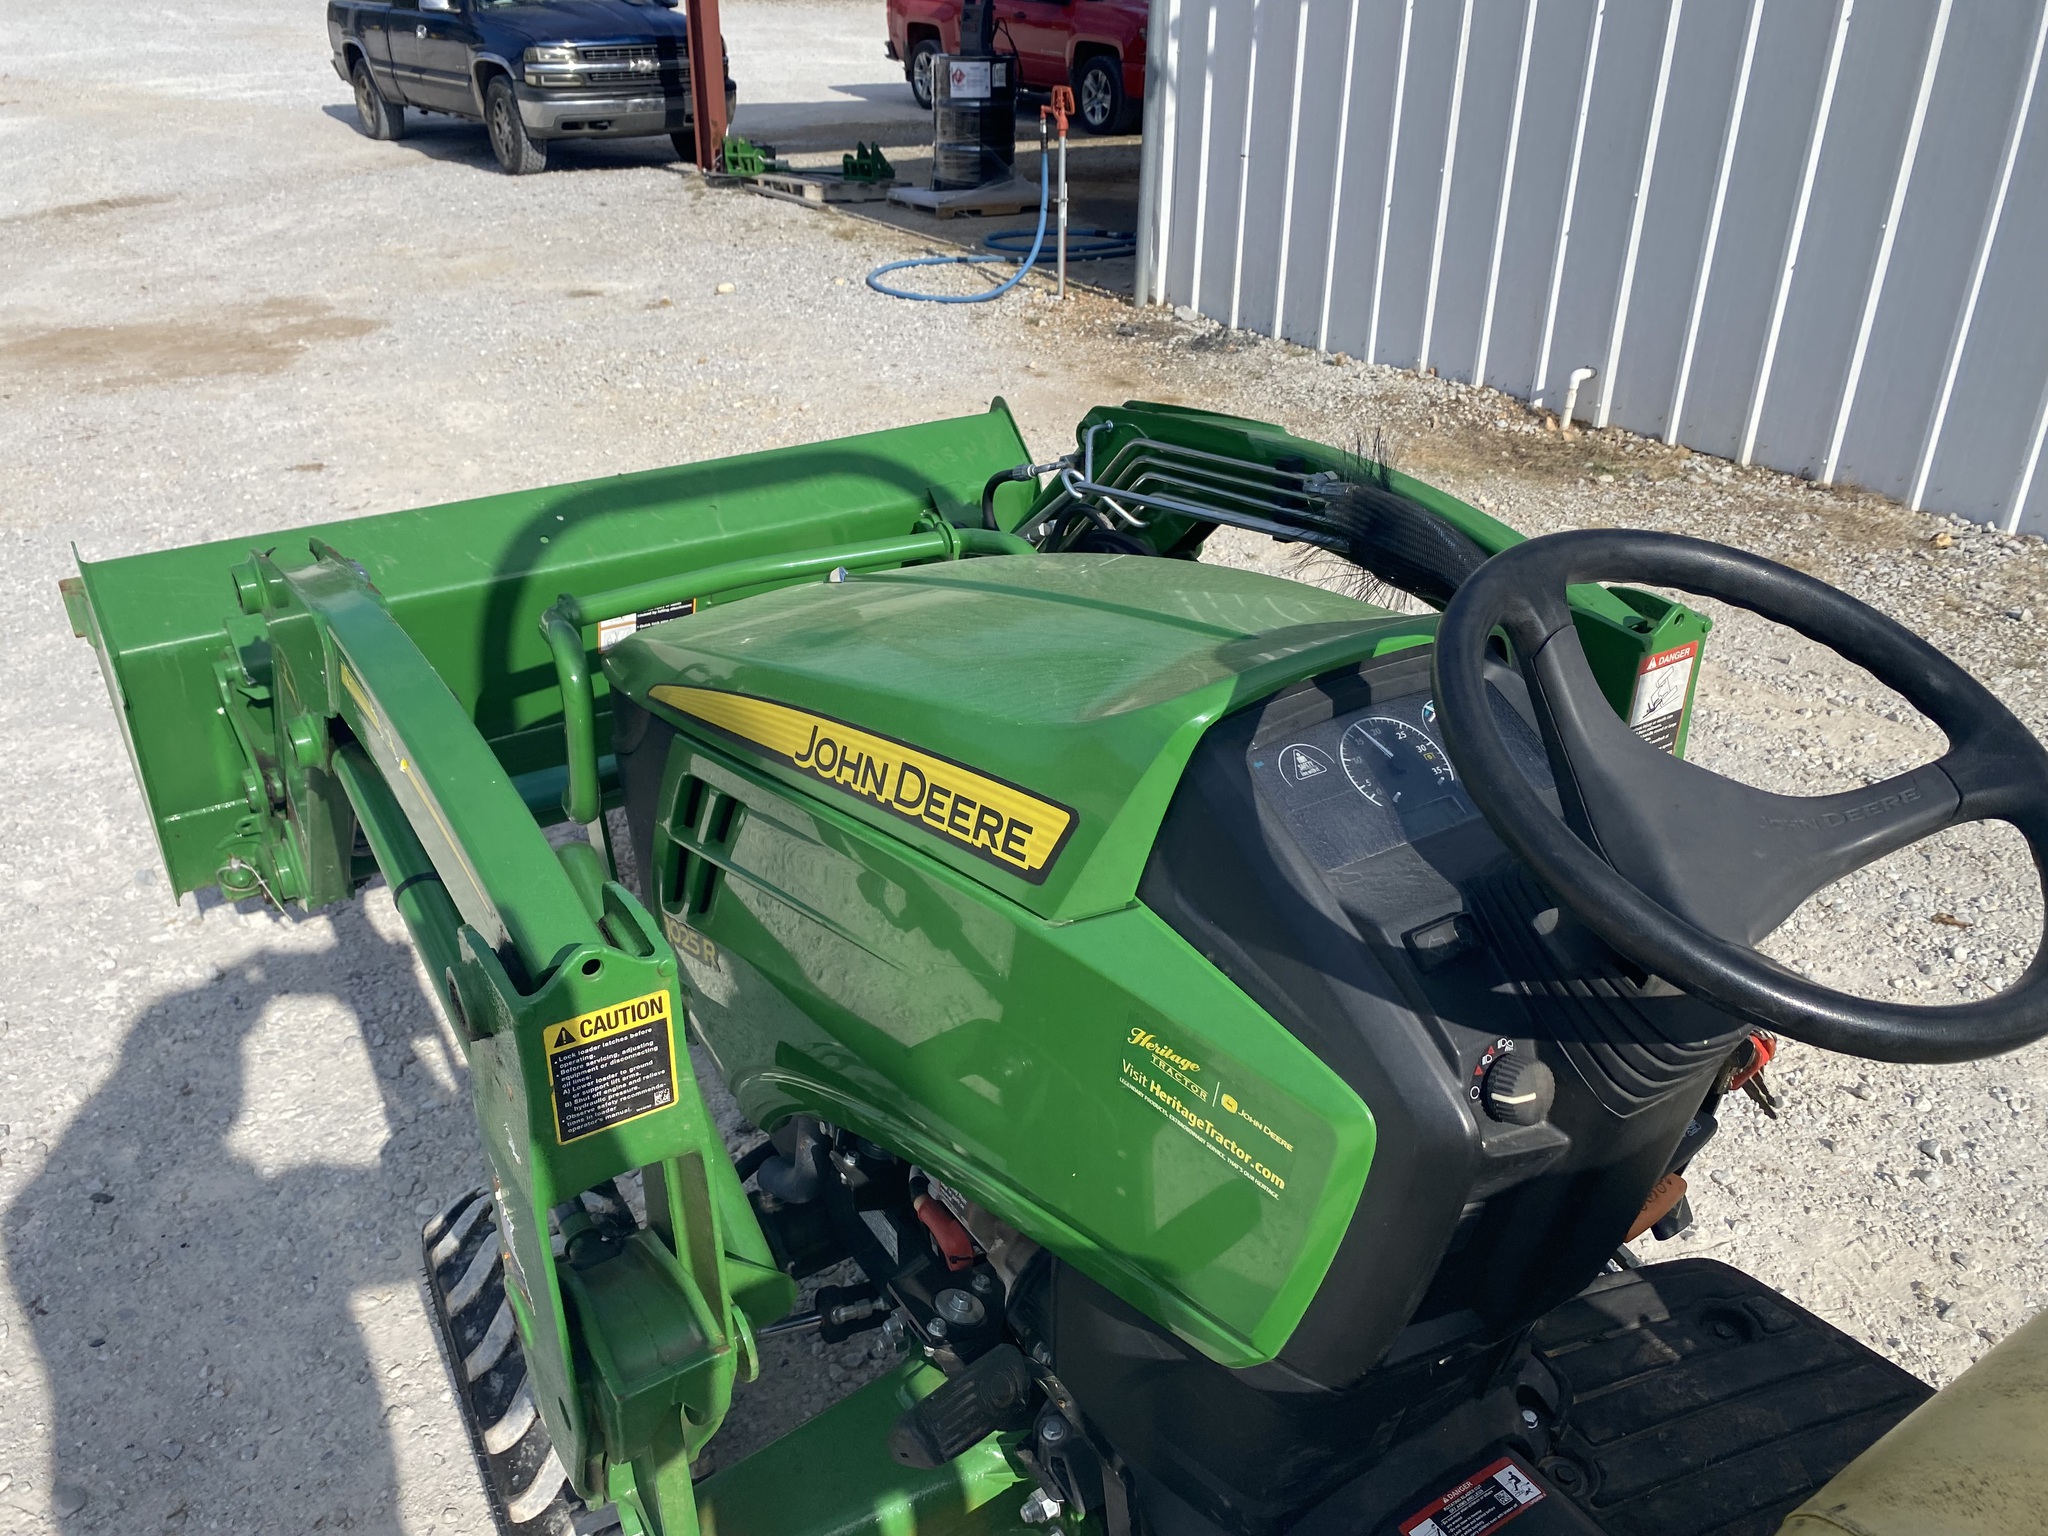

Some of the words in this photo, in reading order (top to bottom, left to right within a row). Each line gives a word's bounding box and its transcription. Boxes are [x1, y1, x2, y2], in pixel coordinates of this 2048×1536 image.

[1658, 648, 1690, 666] DANGER
[1355, 737, 1364, 745] 15
[1370, 727, 1381, 735] 20
[1395, 730, 1406, 739] 25
[1352, 756, 1362, 764] 10
[1415, 744, 1426, 752] 30
[1431, 766, 1442, 774] 35
[795, 725, 888, 797] JOHN
[894, 761, 1033, 863] DEERE
[1822, 788, 1922, 827] DEERE
[580, 996, 663, 1038] CAUTION
[558, 1051, 576, 1062] Lock
[578, 1043, 600, 1056] loader
[602, 1034, 628, 1048] latches
[629, 1026, 652, 1039] before
[560, 1062, 583, 1075] Before
[585, 1050, 620, 1067] servicing,
[621, 1039, 653, 1055] adjusting
[1128, 1027, 1201, 1072] Heritage
[559, 1052, 595, 1069] operating.
[561, 1064, 598, 1082] equipment
[609, 1044, 658, 1066] disconnecting
[572, 1080, 593, 1091] Lower
[595, 1072, 617, 1083] loader
[629, 1059, 653, 1073] ground
[574, 1094, 590, 1104] Shut
[592, 1090, 601, 1098] off
[603, 1082, 626, 1095] engine
[628, 1077, 641, 1085] and
[642, 1068, 665, 1080] relieve
[581, 1081, 609, 1096] support
[610, 1077, 620, 1085] lift
[622, 1070, 641, 1081] arms.
[1151, 1055, 1208, 1101] TRACTOR
[566, 1106, 594, 1120] Observe
[596, 1098, 618, 1110] safety
[573, 1095, 606, 1112] hydraulic
[608, 1084, 640, 1100] pressure.
[567, 1117, 584, 1127] tions
[594, 1105, 616, 1117] loader
[567, 1116, 603, 1134] operator's
[604, 1105, 632, 1120] manual.
[1122, 1058, 1148, 1087] Visit
[1150, 1080, 1285, 1190] HeritageTractor.com
[1238, 1109, 1262, 1131] JOHN
[1263, 1125, 1294, 1152] DEERE
[1447, 1481, 1473, 1499] DANGER
